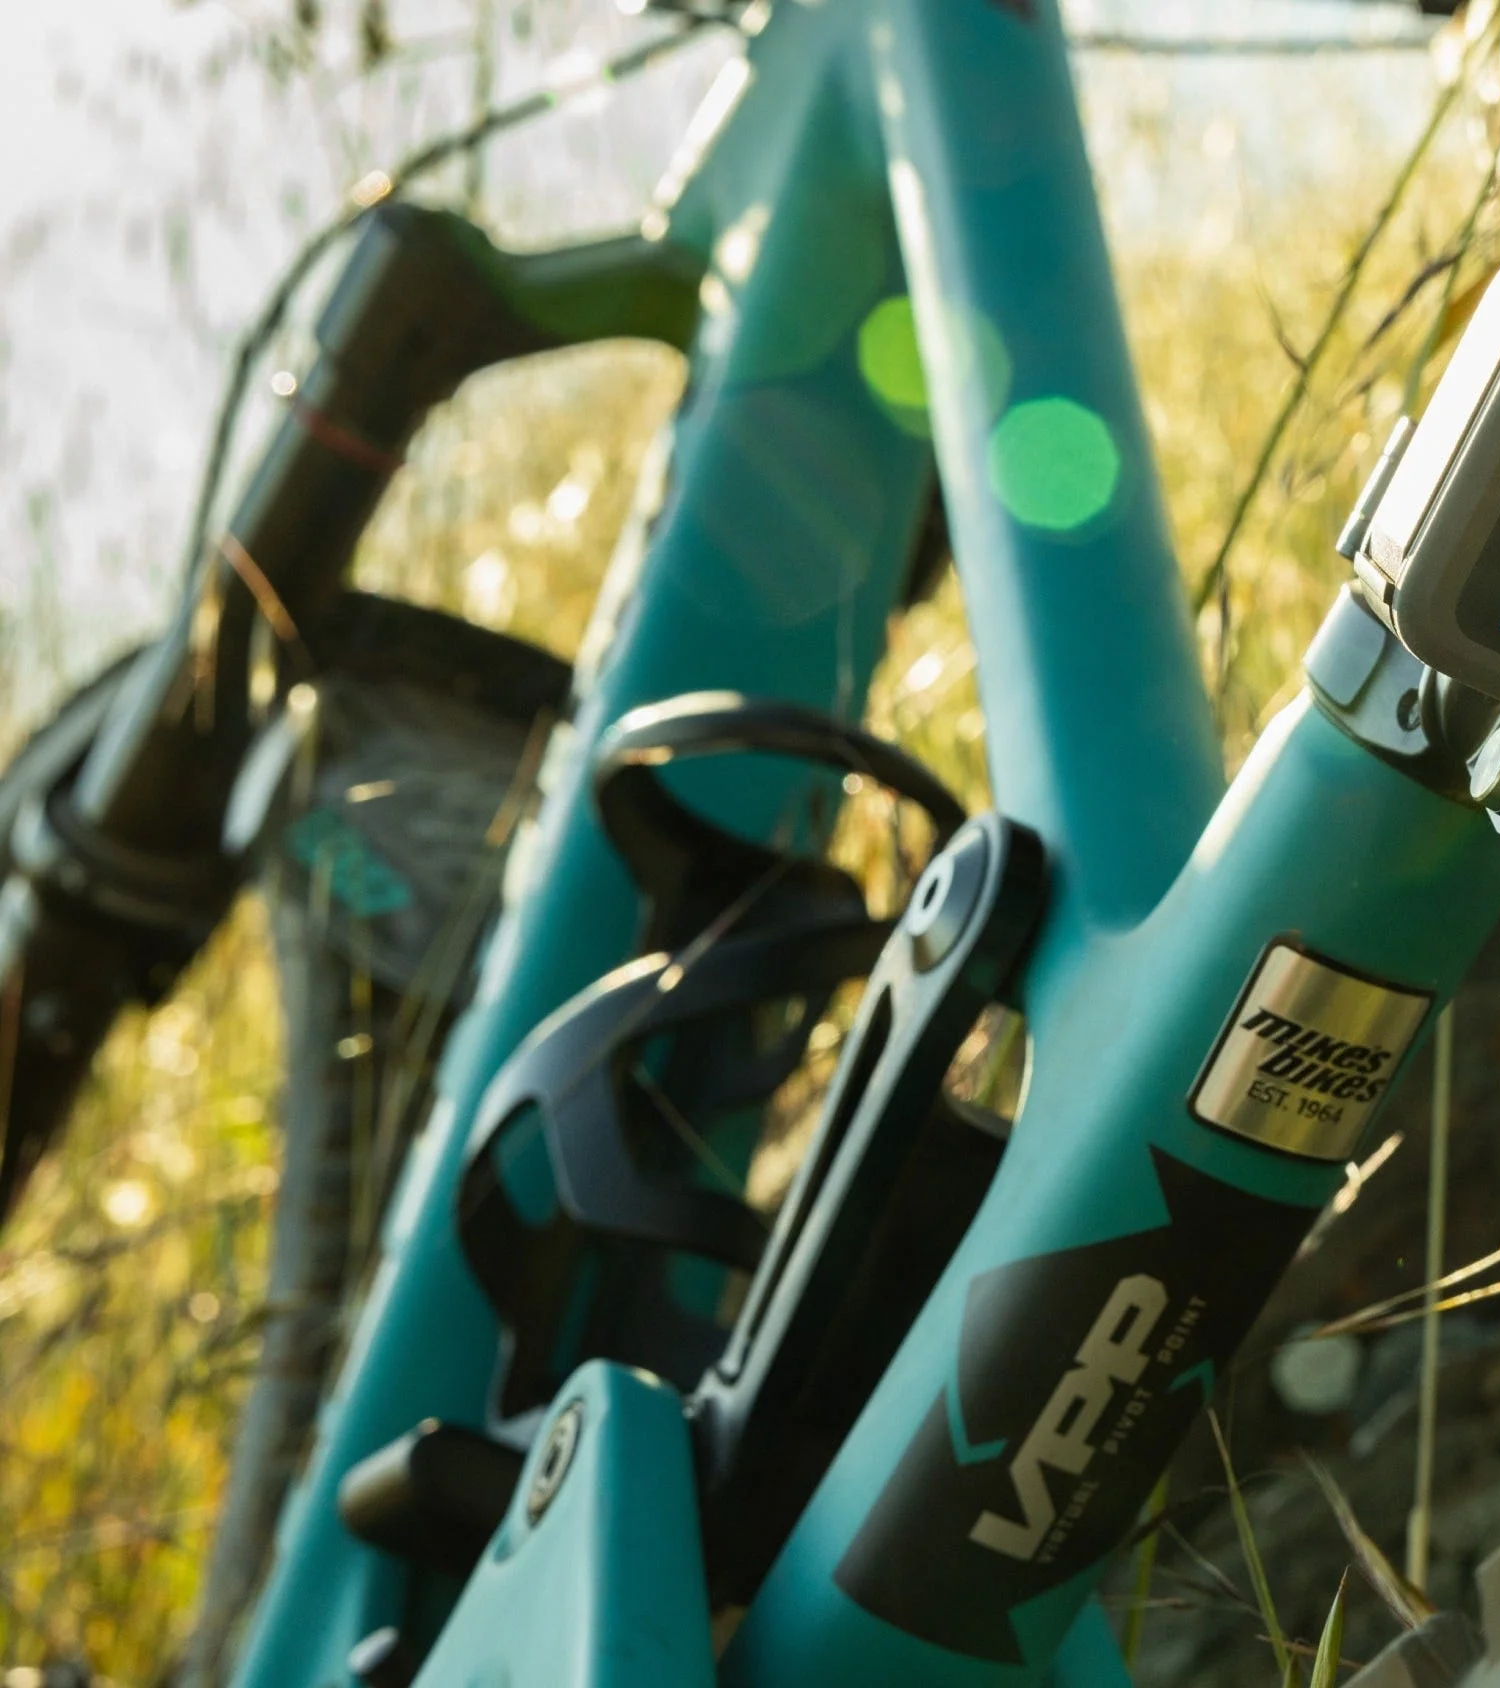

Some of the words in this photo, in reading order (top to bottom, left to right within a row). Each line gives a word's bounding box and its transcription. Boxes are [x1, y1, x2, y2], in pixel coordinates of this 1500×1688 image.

[1247, 1080, 1289, 1112] EST.
[1297, 1098, 1344, 1125] 1964
[1258, 1045, 1387, 1103] bikes
[968, 1273, 1168, 1561] VPP
[1103, 1386, 1153, 1455] PIVOT
[1157, 1296, 1207, 1365] POINT
